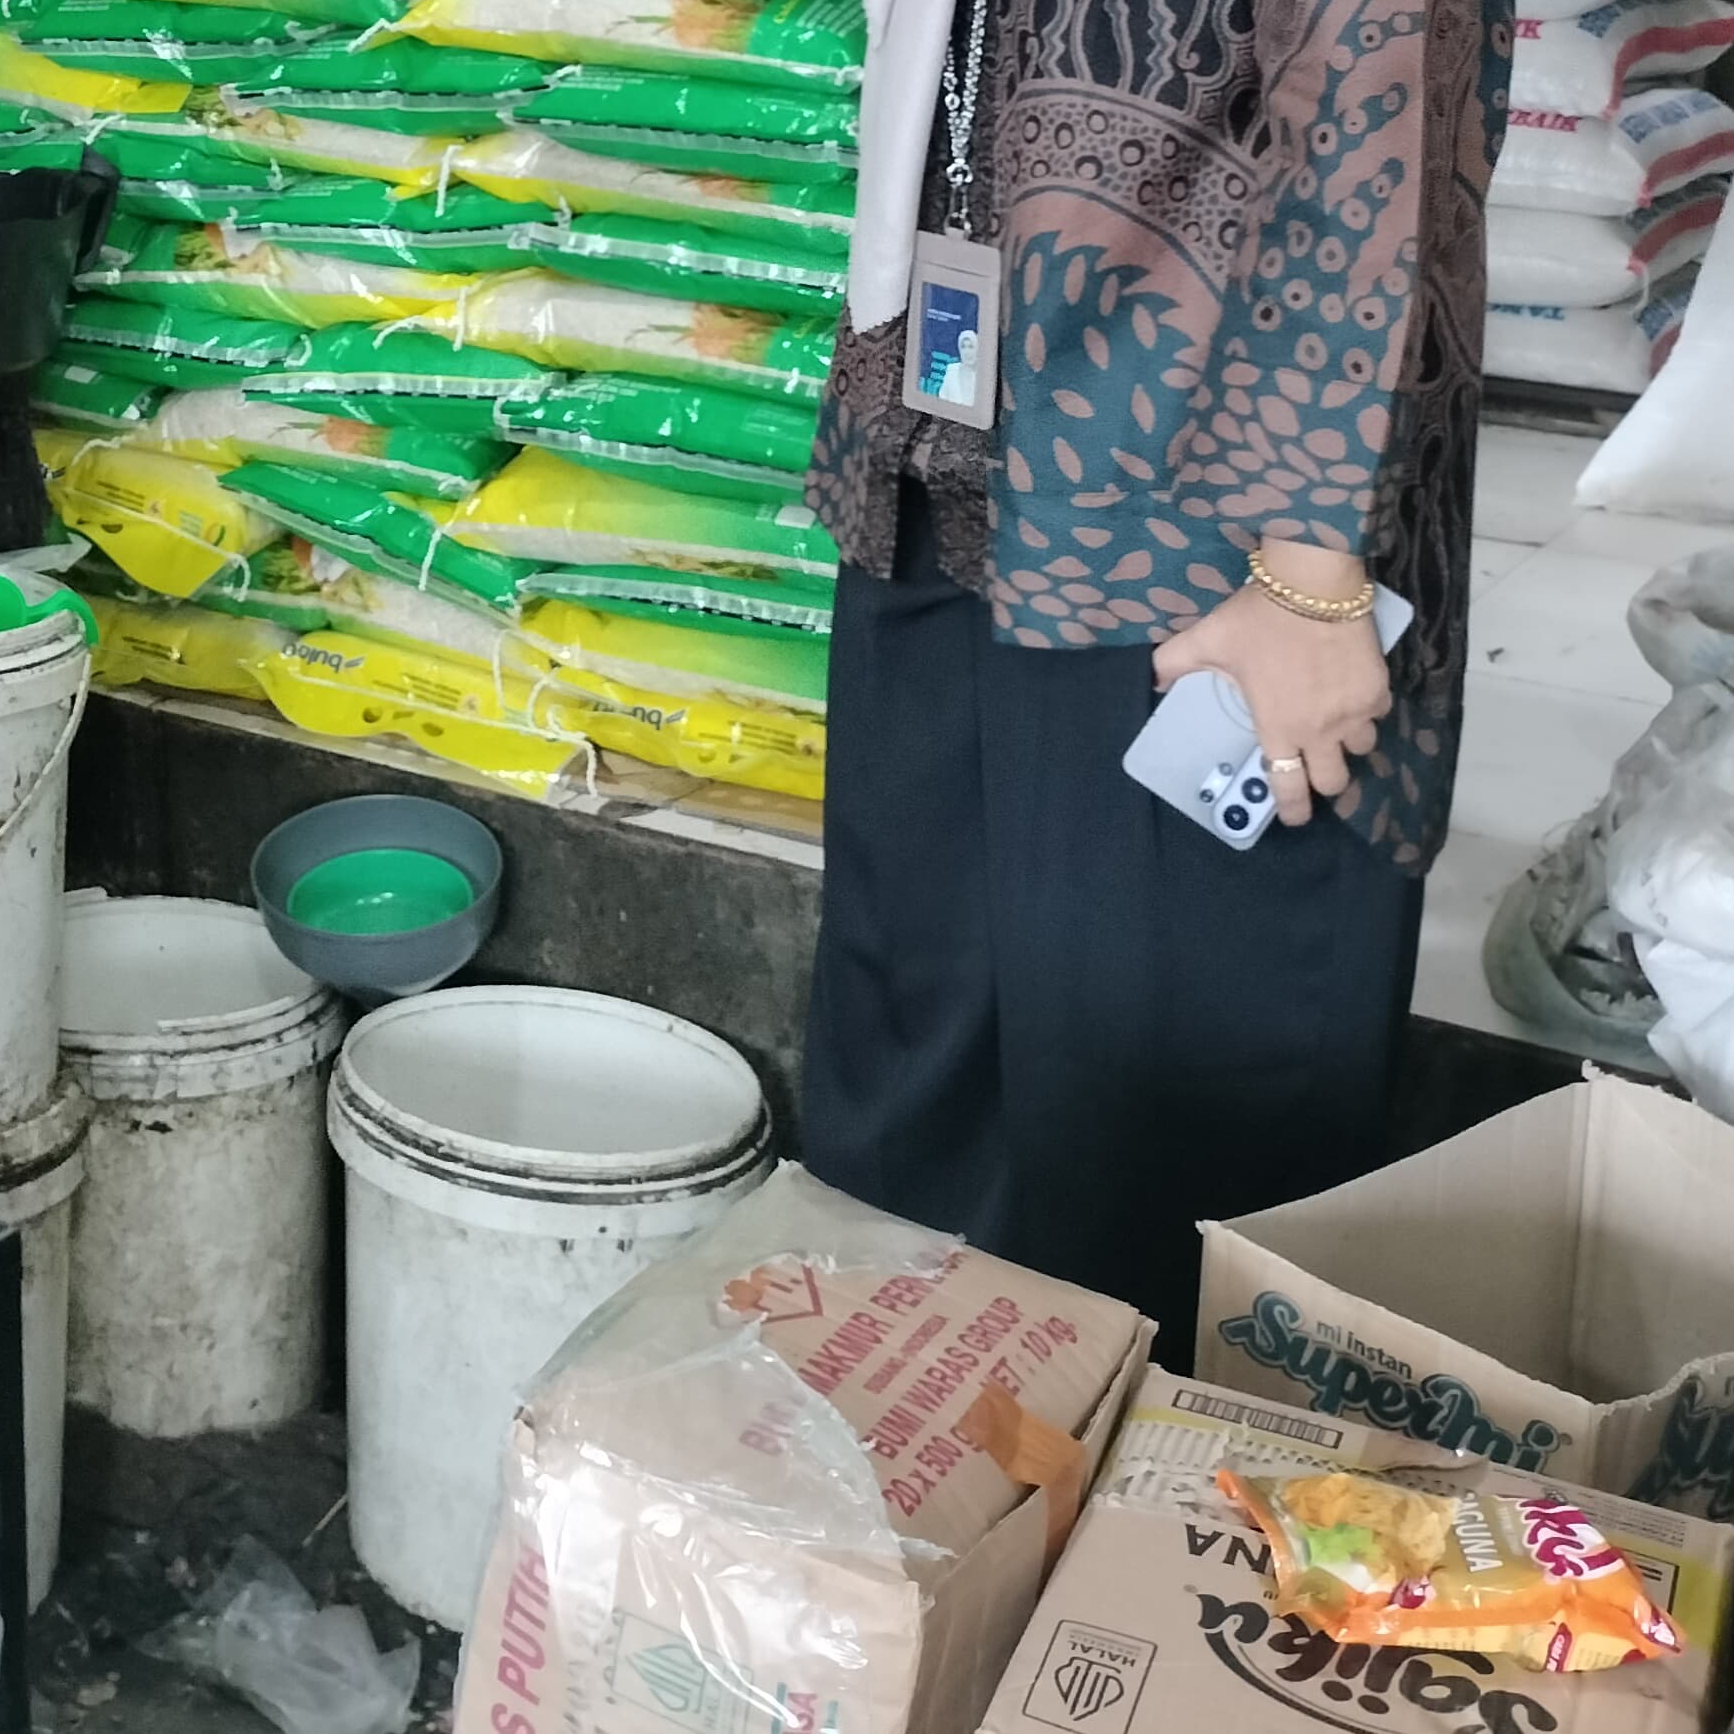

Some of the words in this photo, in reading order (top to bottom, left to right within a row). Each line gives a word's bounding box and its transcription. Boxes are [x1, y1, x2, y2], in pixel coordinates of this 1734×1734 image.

[1020, 1330, 1054, 1364] 10
[1316, 1320, 1342, 1345] mi
[1346, 1331, 1412, 1380] instan
[863, 1413, 927, 1461] BUMI
[906, 1346, 981, 1414] WARAS
[958, 1296, 1025, 1359] GROUP
[881, 1477, 923, 1517] 20
[915, 1436, 964, 1478] 500
[1068, 1640, 1136, 1668] HALAL
